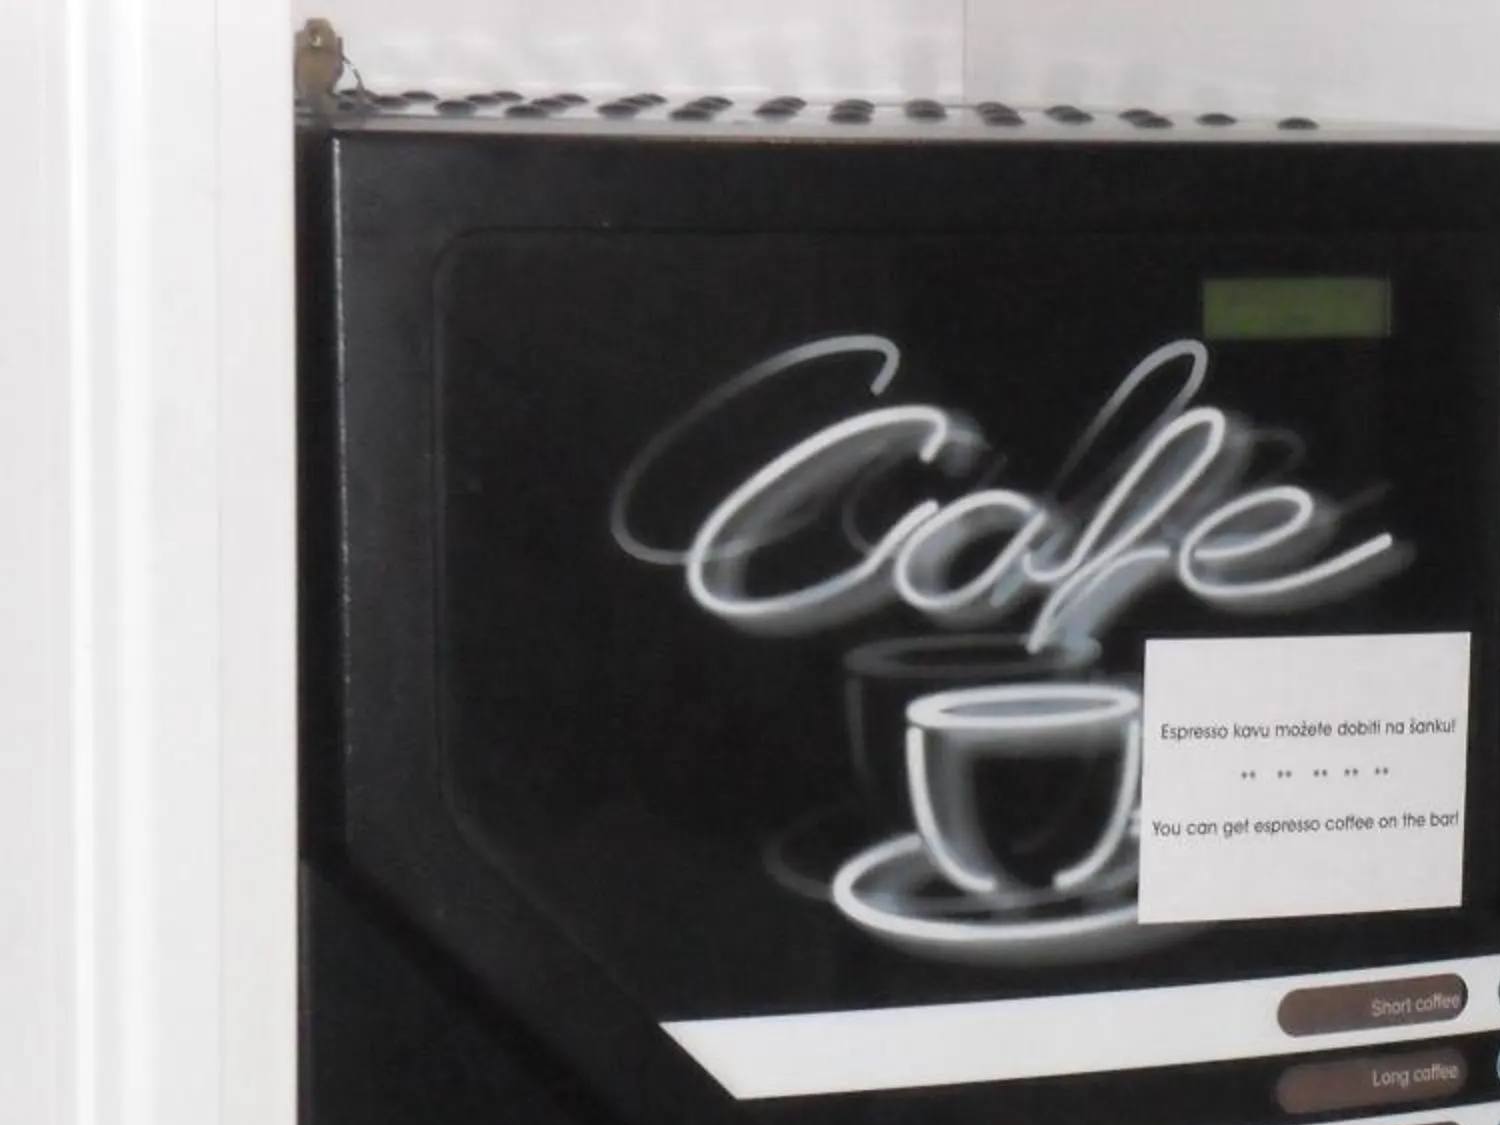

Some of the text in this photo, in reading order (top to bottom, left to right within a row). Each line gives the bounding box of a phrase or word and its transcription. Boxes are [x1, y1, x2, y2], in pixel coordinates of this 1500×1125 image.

[683, 404, 1396, 655] Cafe
[1160, 716, 1457, 742] Espresso kavu možete dobiti na šanku!
[1151, 809, 1460, 839] You can get espresso coffee on the bar!
[1371, 992, 1461, 1017] Short coffee
[1372, 1062, 1459, 1088] Long coffee
